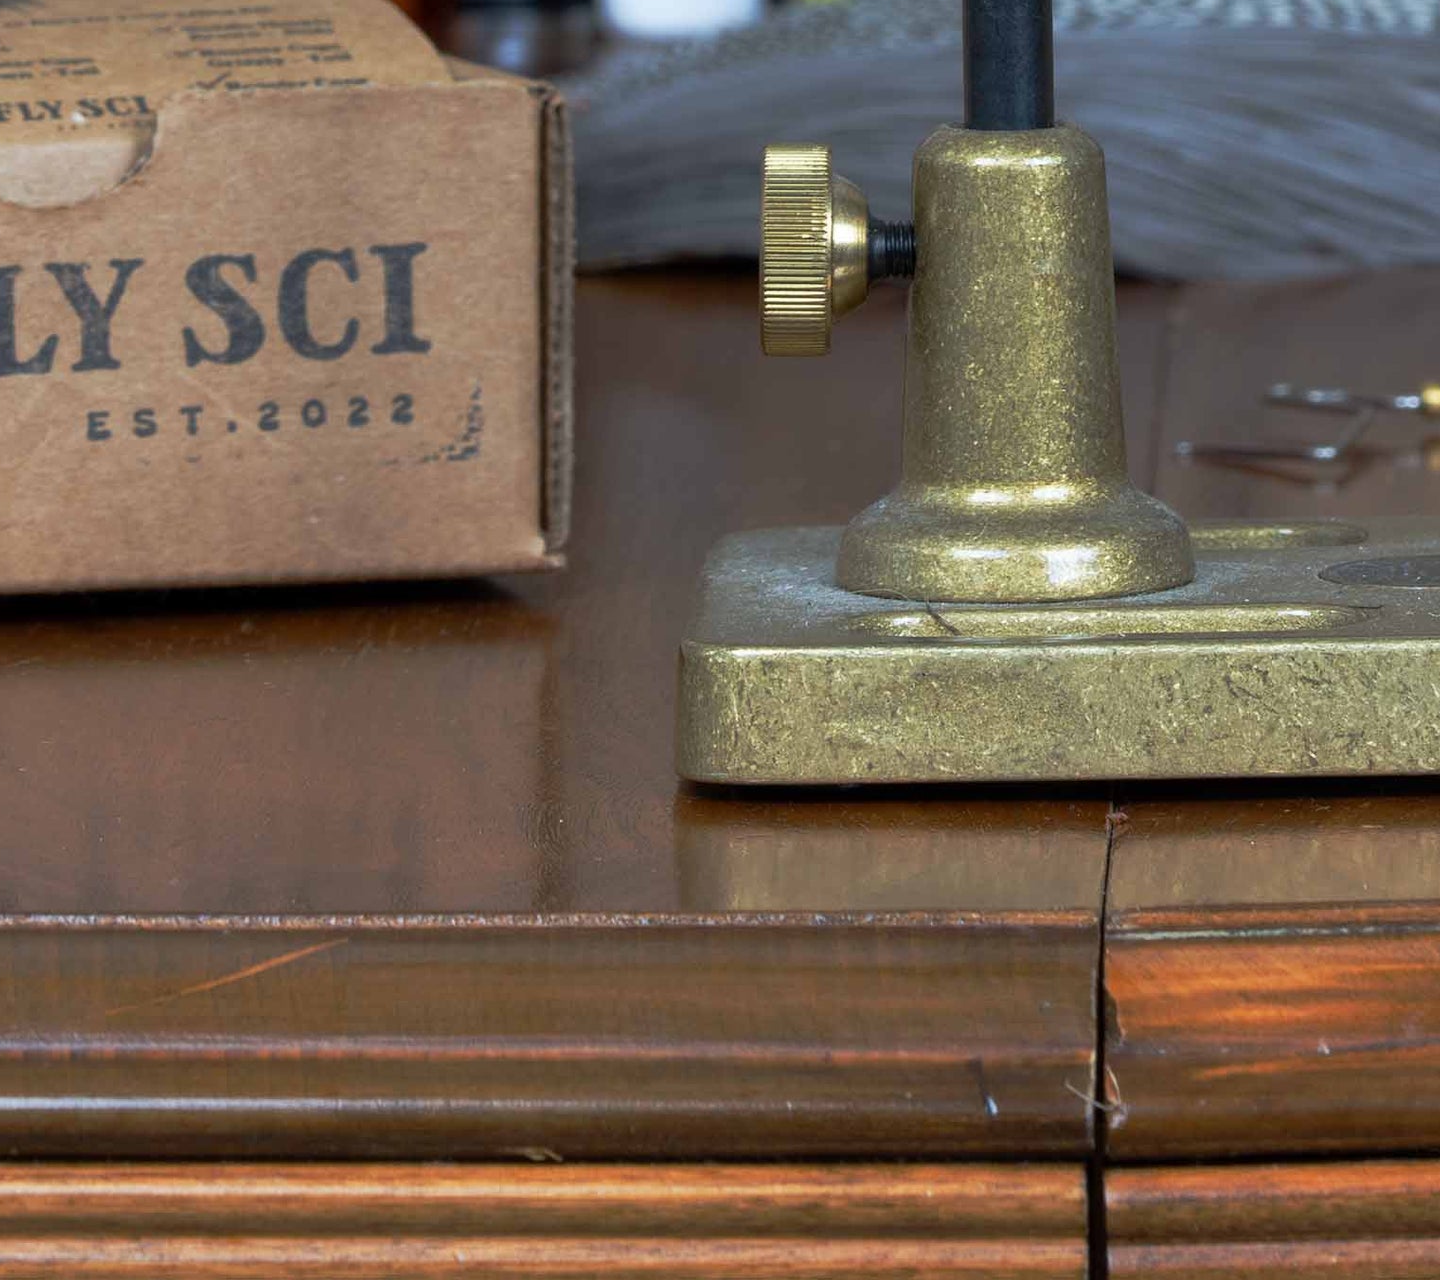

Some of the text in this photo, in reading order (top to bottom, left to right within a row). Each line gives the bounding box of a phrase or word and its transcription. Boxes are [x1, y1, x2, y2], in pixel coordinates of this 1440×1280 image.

[72, 94, 153, 121] SCI
[182, 241, 432, 368] SCI
[86, 393, 417, 442] EST.2022
